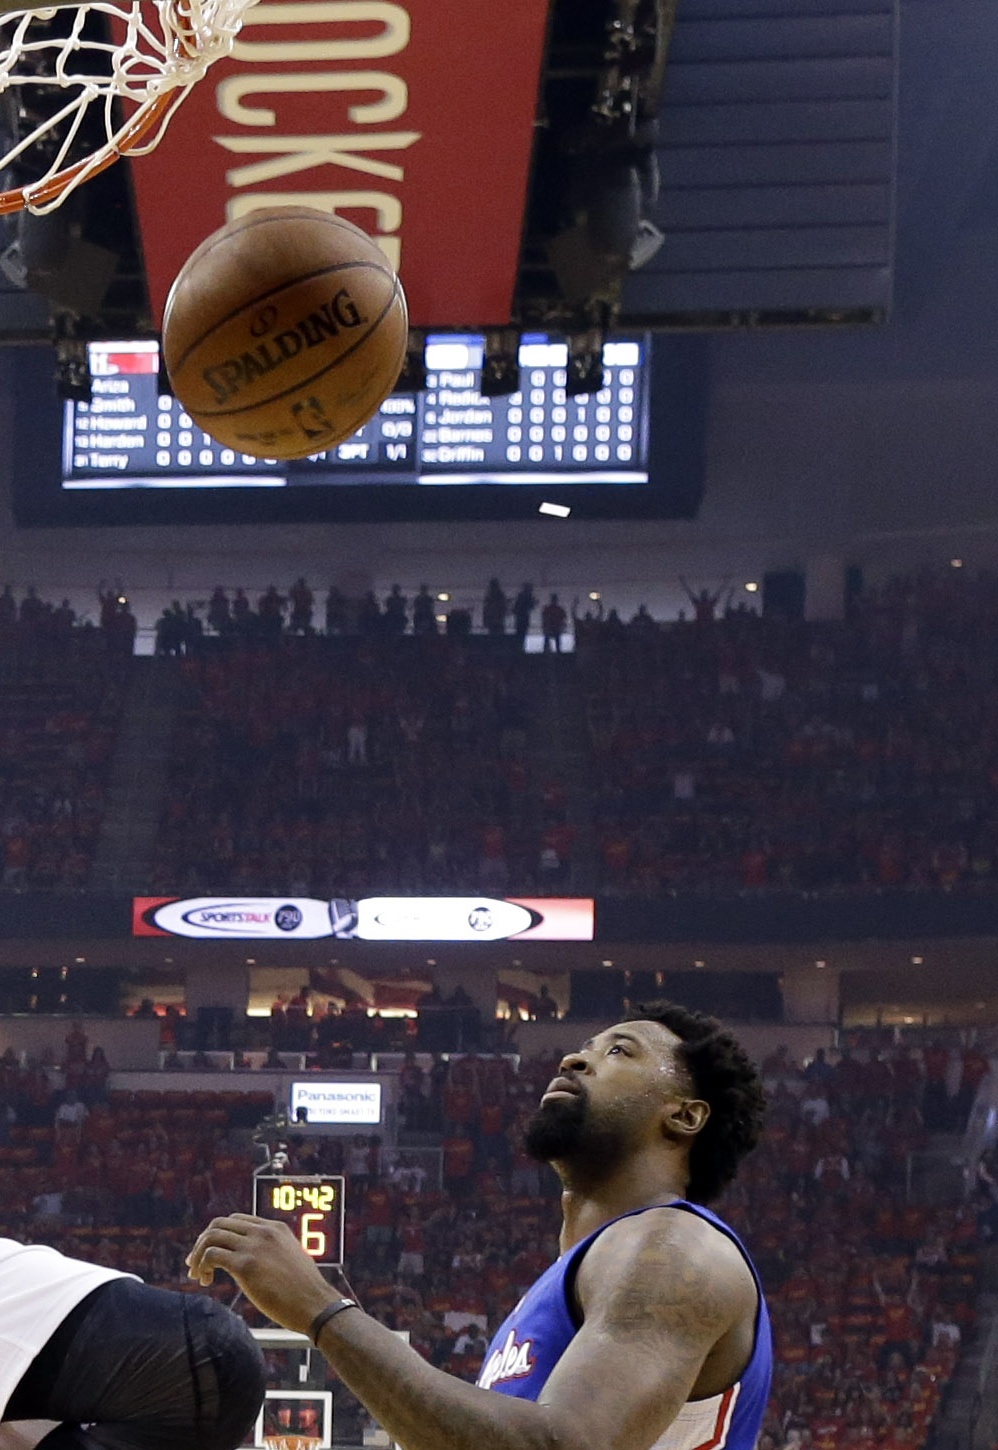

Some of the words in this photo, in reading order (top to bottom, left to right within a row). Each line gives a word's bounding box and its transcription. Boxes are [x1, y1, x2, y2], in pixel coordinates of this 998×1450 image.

[203, 288, 367, 405] SPALDING
[438, 408, 492, 424] Jordan
[90, 453, 129, 470] Terry
[438, 446, 484, 462] Griffin
[297, 1089, 376, 1102] Panasonic
[273, 1185, 335, 1211] 10:42
[301, 1213, 326, 1256] 6
